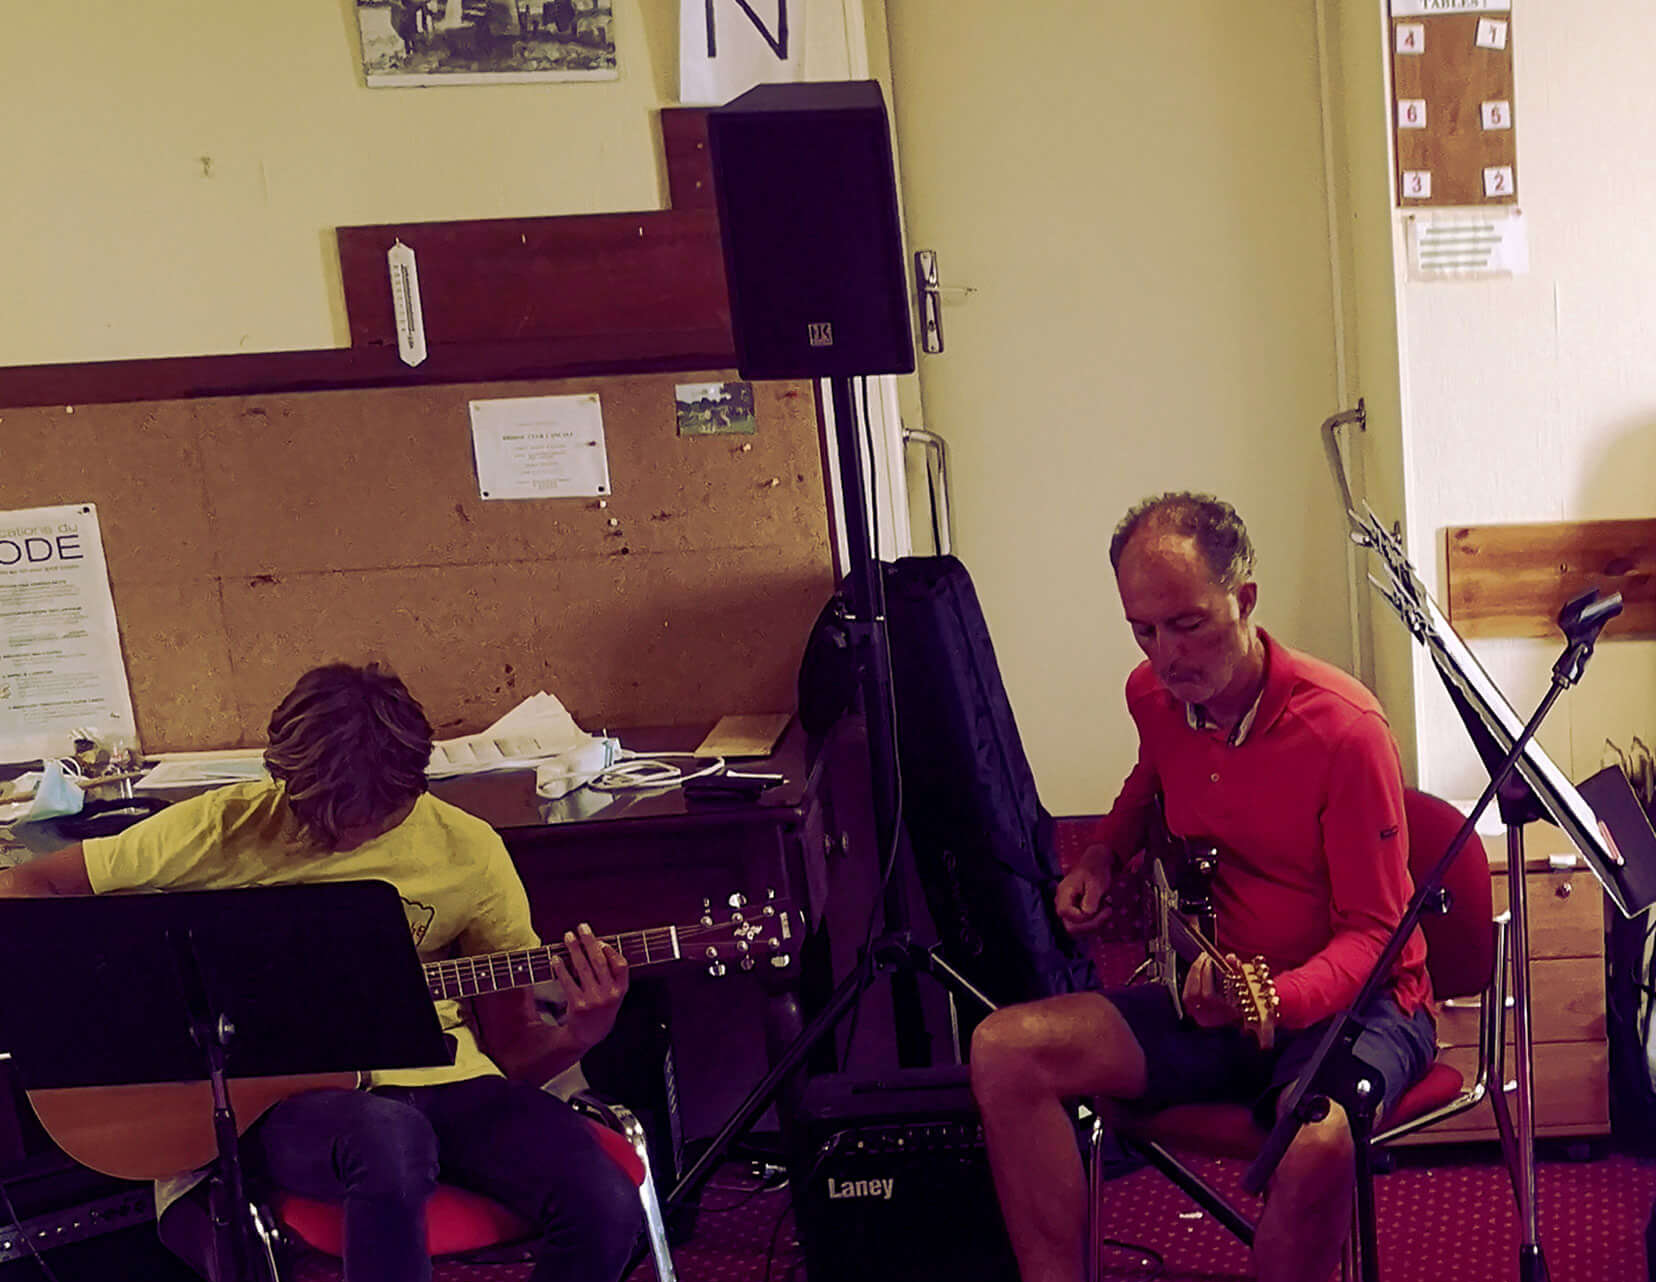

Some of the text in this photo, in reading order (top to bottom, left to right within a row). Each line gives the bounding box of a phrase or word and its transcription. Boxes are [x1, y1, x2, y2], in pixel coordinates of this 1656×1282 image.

[705, 0, 788, 60] N
[1407, 105, 1418, 123] 6
[1412, 174, 1505, 193] 3 2
[0, 534, 84, 565] ODE
[827, 1177, 894, 1200] Laney
